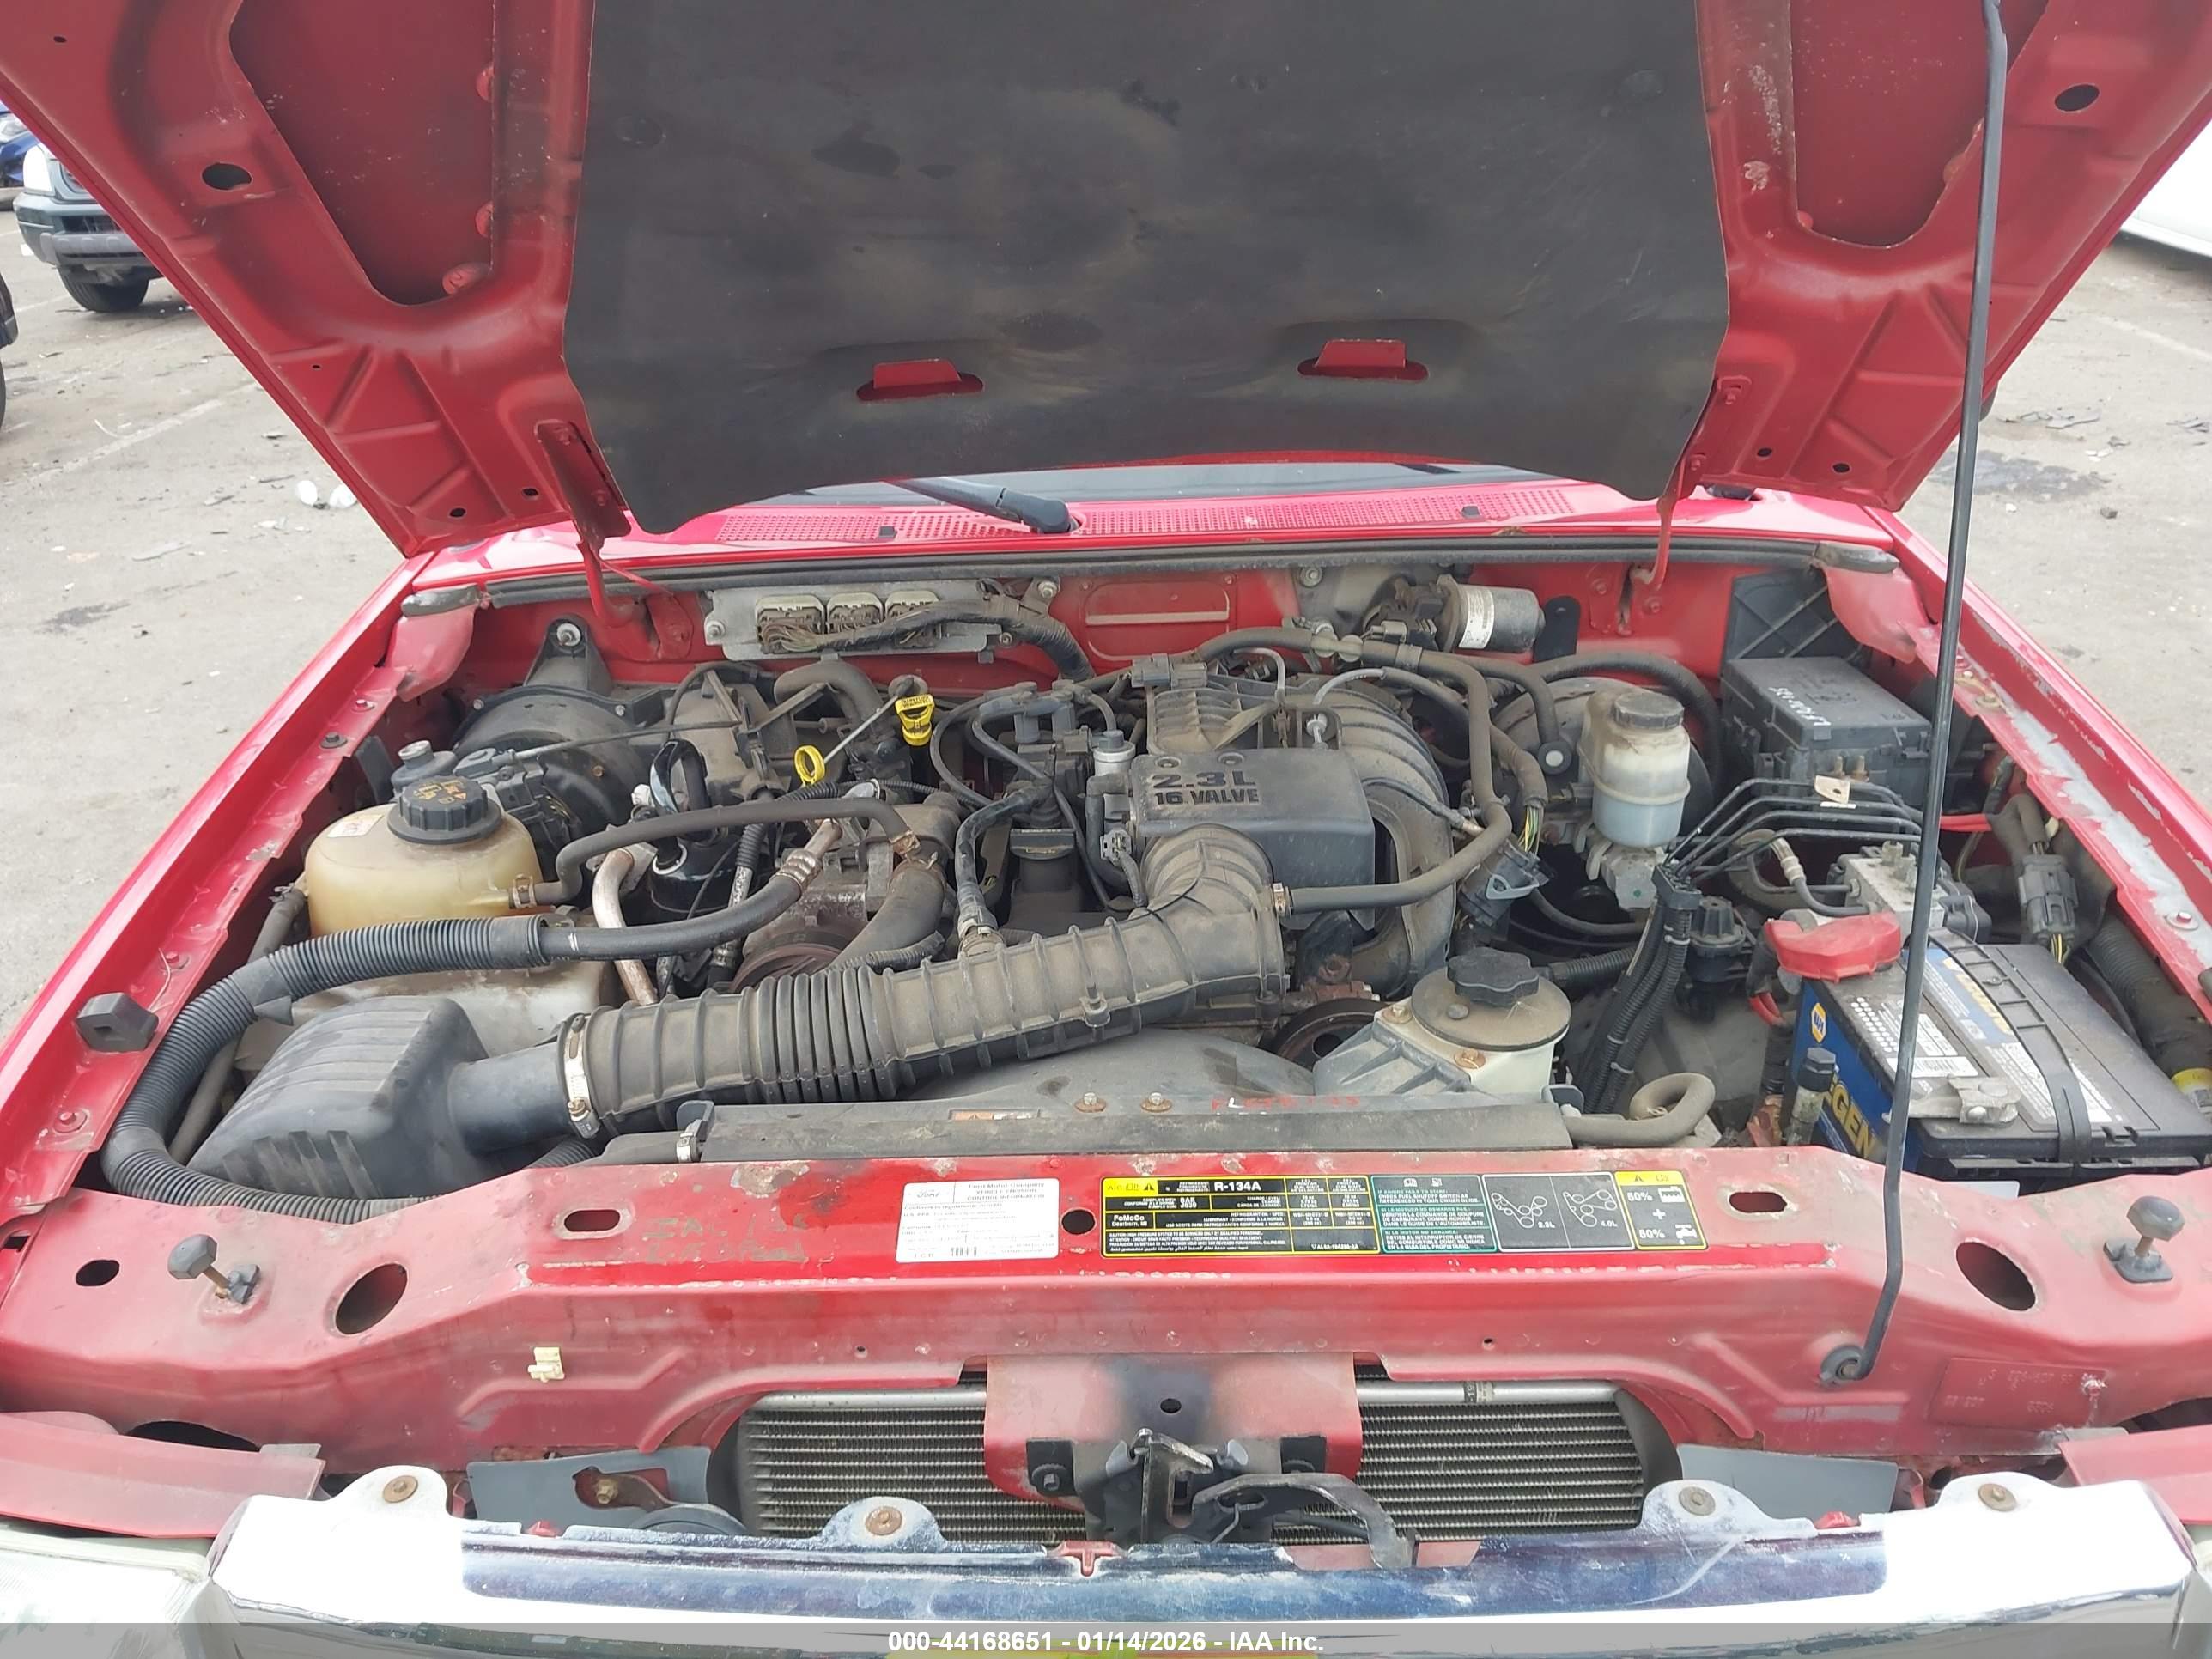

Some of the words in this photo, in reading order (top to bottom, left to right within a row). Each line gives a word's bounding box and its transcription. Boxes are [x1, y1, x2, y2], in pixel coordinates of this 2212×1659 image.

[1152, 770, 1256, 789] 2.3L
[1154, 791, 1182, 805] 16
[1191, 788, 1260, 805] VALVE
[1213, 1180, 1262, 1192] R-134A
[1626, 1191, 1653, 1202] 50%
[1638, 1229, 1667, 1239] 50%
